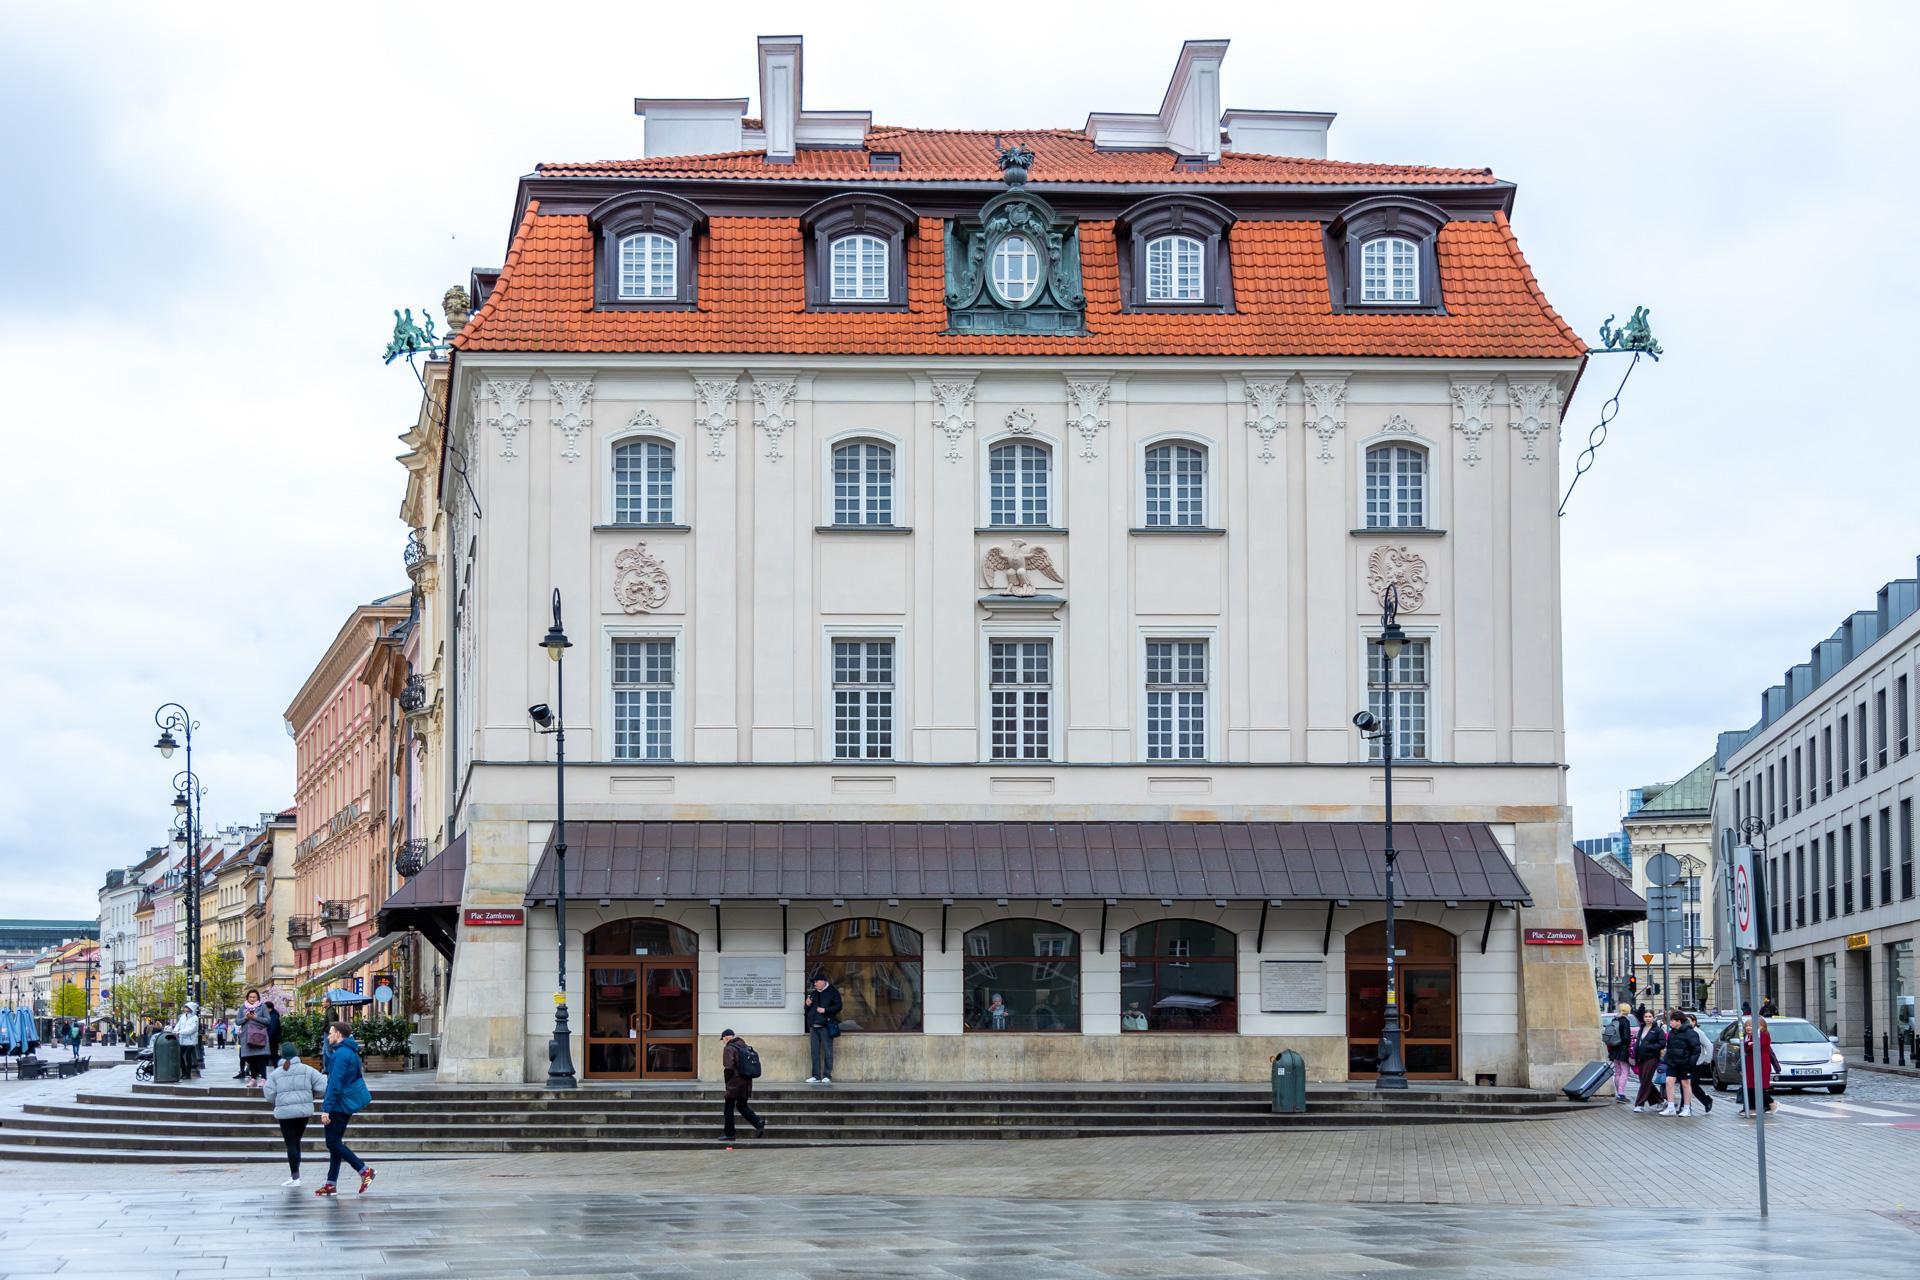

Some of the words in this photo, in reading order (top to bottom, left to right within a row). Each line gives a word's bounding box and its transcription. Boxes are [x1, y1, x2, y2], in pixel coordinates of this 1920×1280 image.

[1738, 882, 1747, 912] 30
[485, 912, 516, 920] Zamkowy
[1532, 931, 1545, 939] Plac
[1547, 931, 1577, 940] Zamkowy
